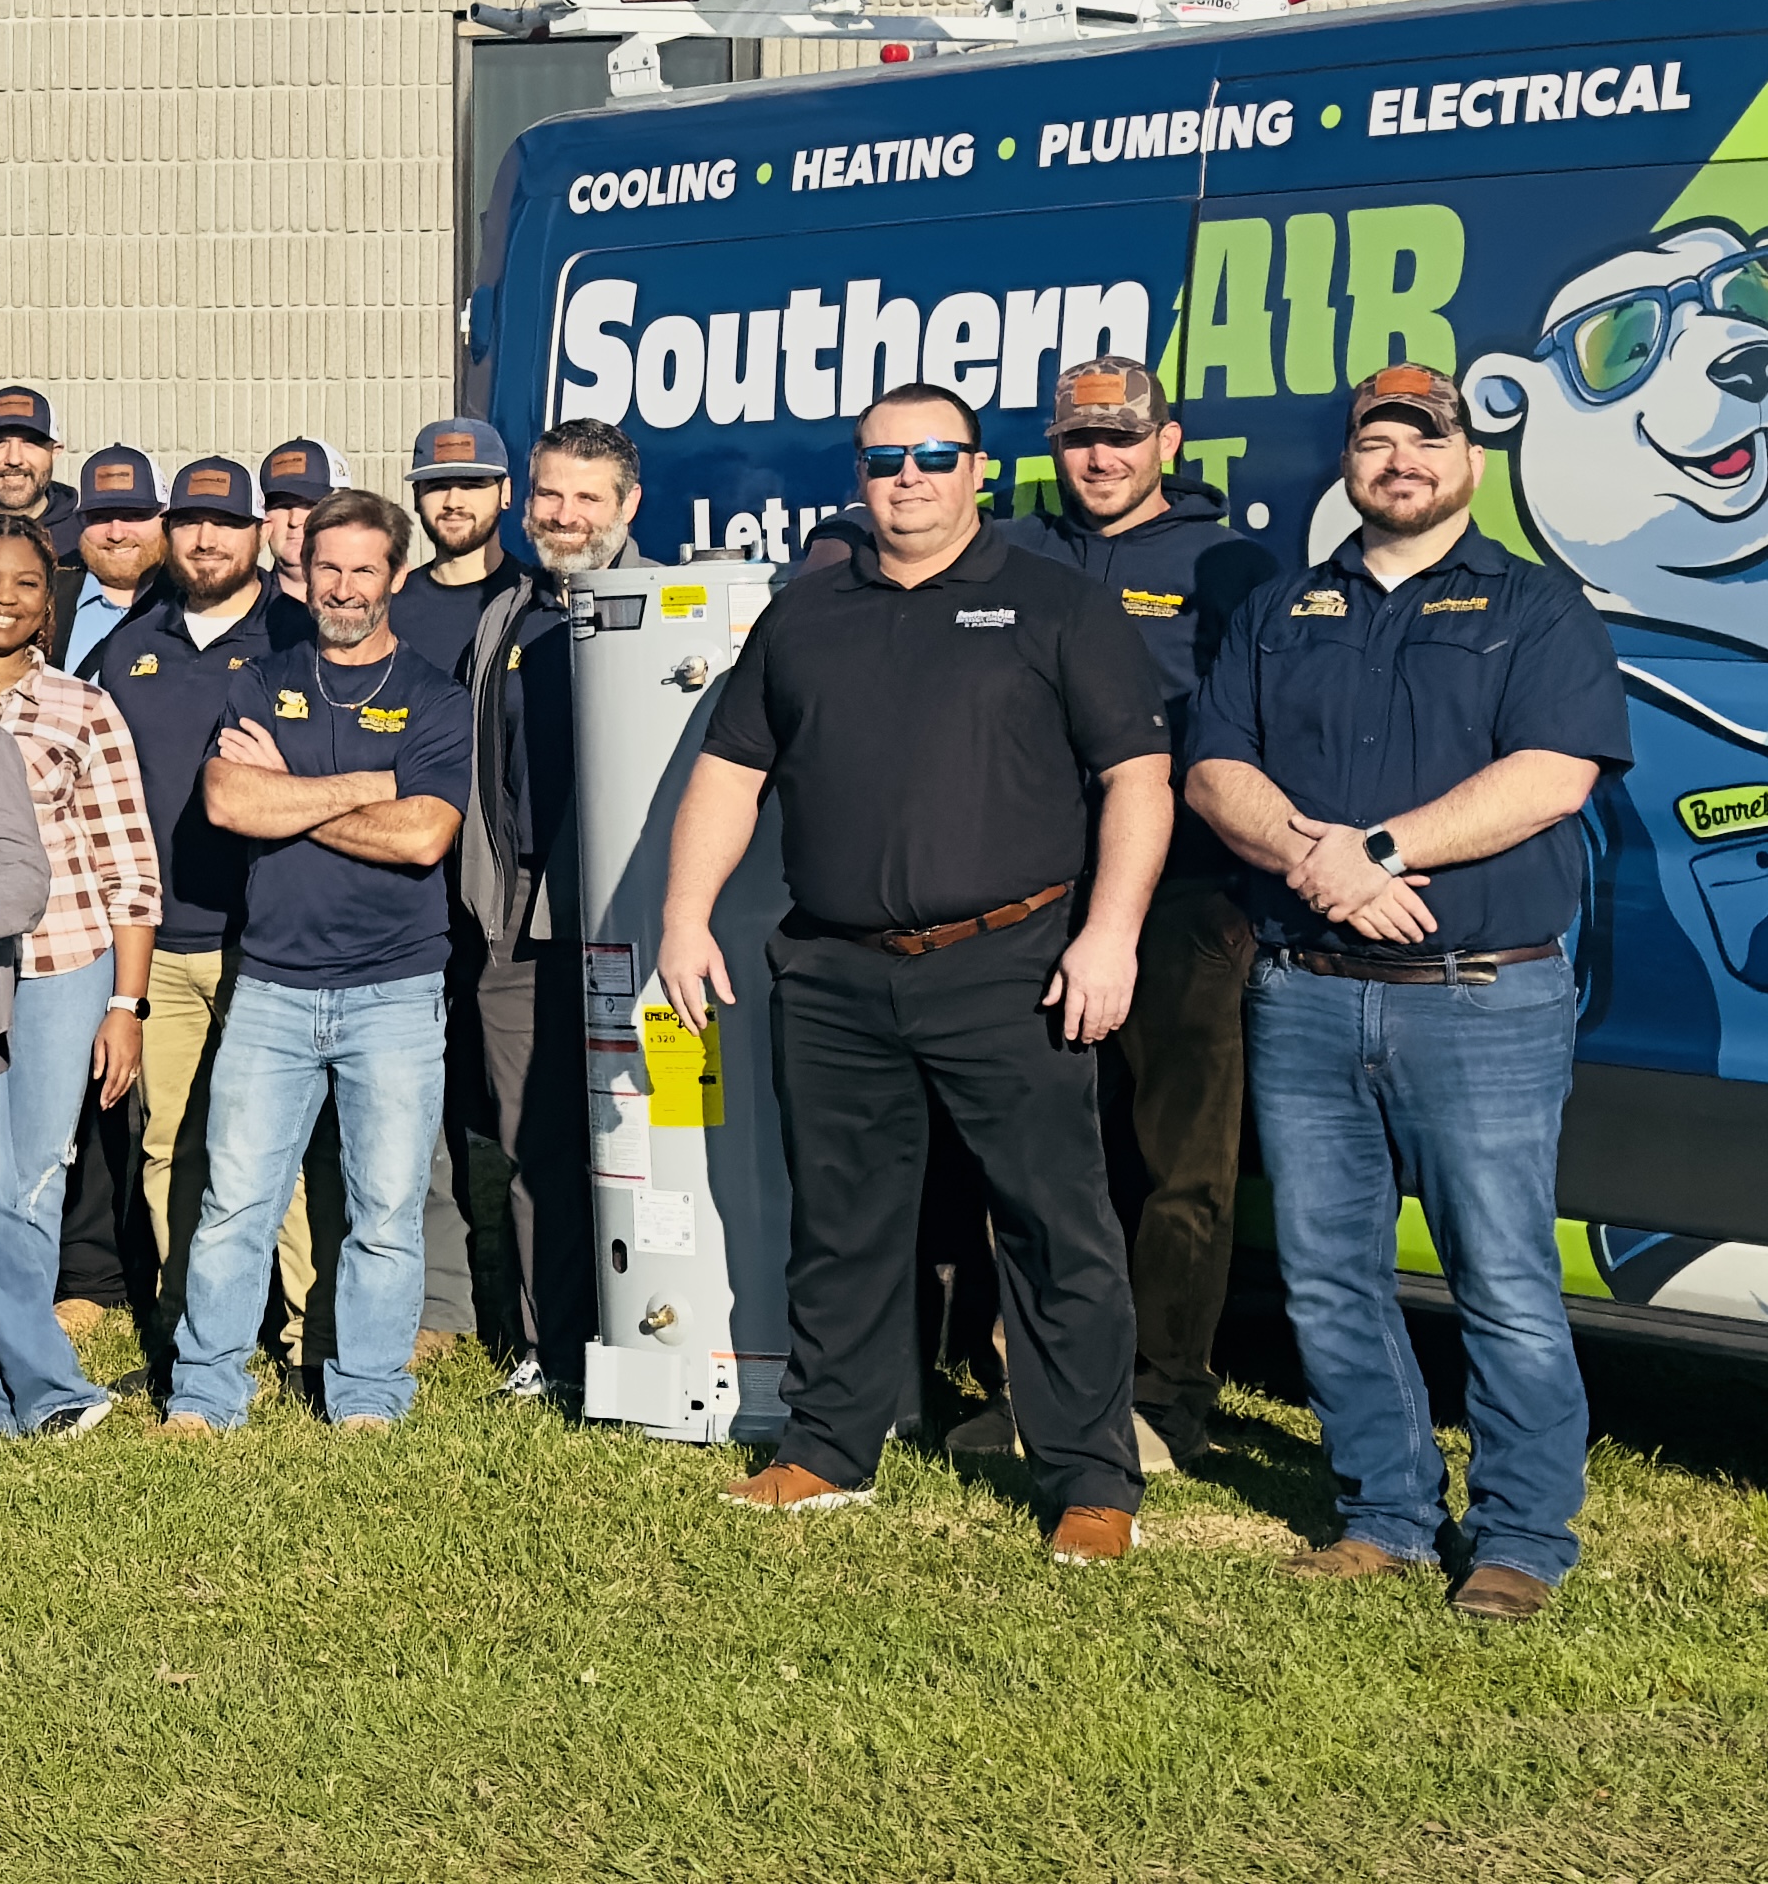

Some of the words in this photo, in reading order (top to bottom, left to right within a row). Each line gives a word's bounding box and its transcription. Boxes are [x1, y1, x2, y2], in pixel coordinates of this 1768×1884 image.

[568, 158, 736, 214] COOLING
[791, 133, 975, 192] HEATING
[1039, 100, 1294, 168] PLUMBING
[1368, 61, 1691, 137] ELECTRICAL
[1689, 791, 1768, 830] Barret
